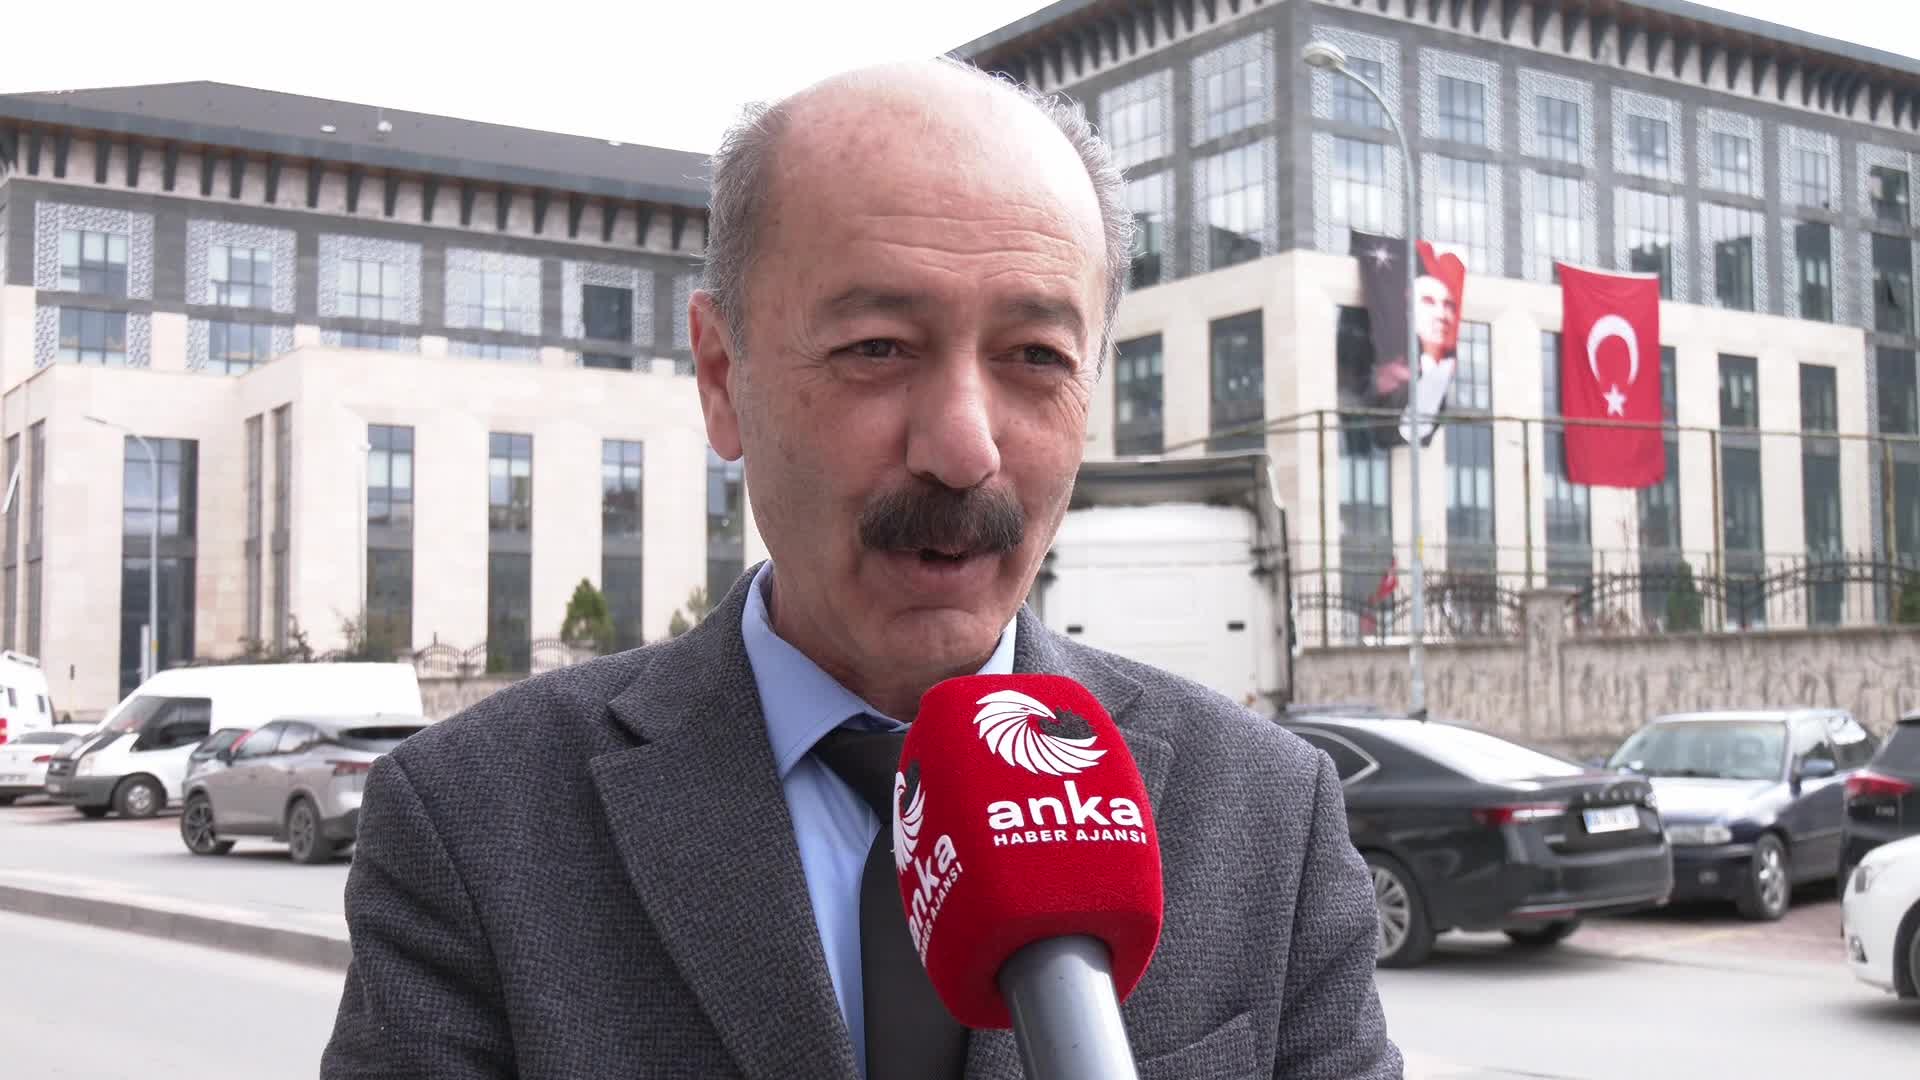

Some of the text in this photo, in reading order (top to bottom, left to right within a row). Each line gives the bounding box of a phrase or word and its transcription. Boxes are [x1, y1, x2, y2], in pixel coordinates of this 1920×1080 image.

[987, 780, 1144, 830] anka
[994, 829, 1147, 846] HABER AJANSI
[909, 834, 957, 953] anka
[930, 861, 963, 921] AJANSI
